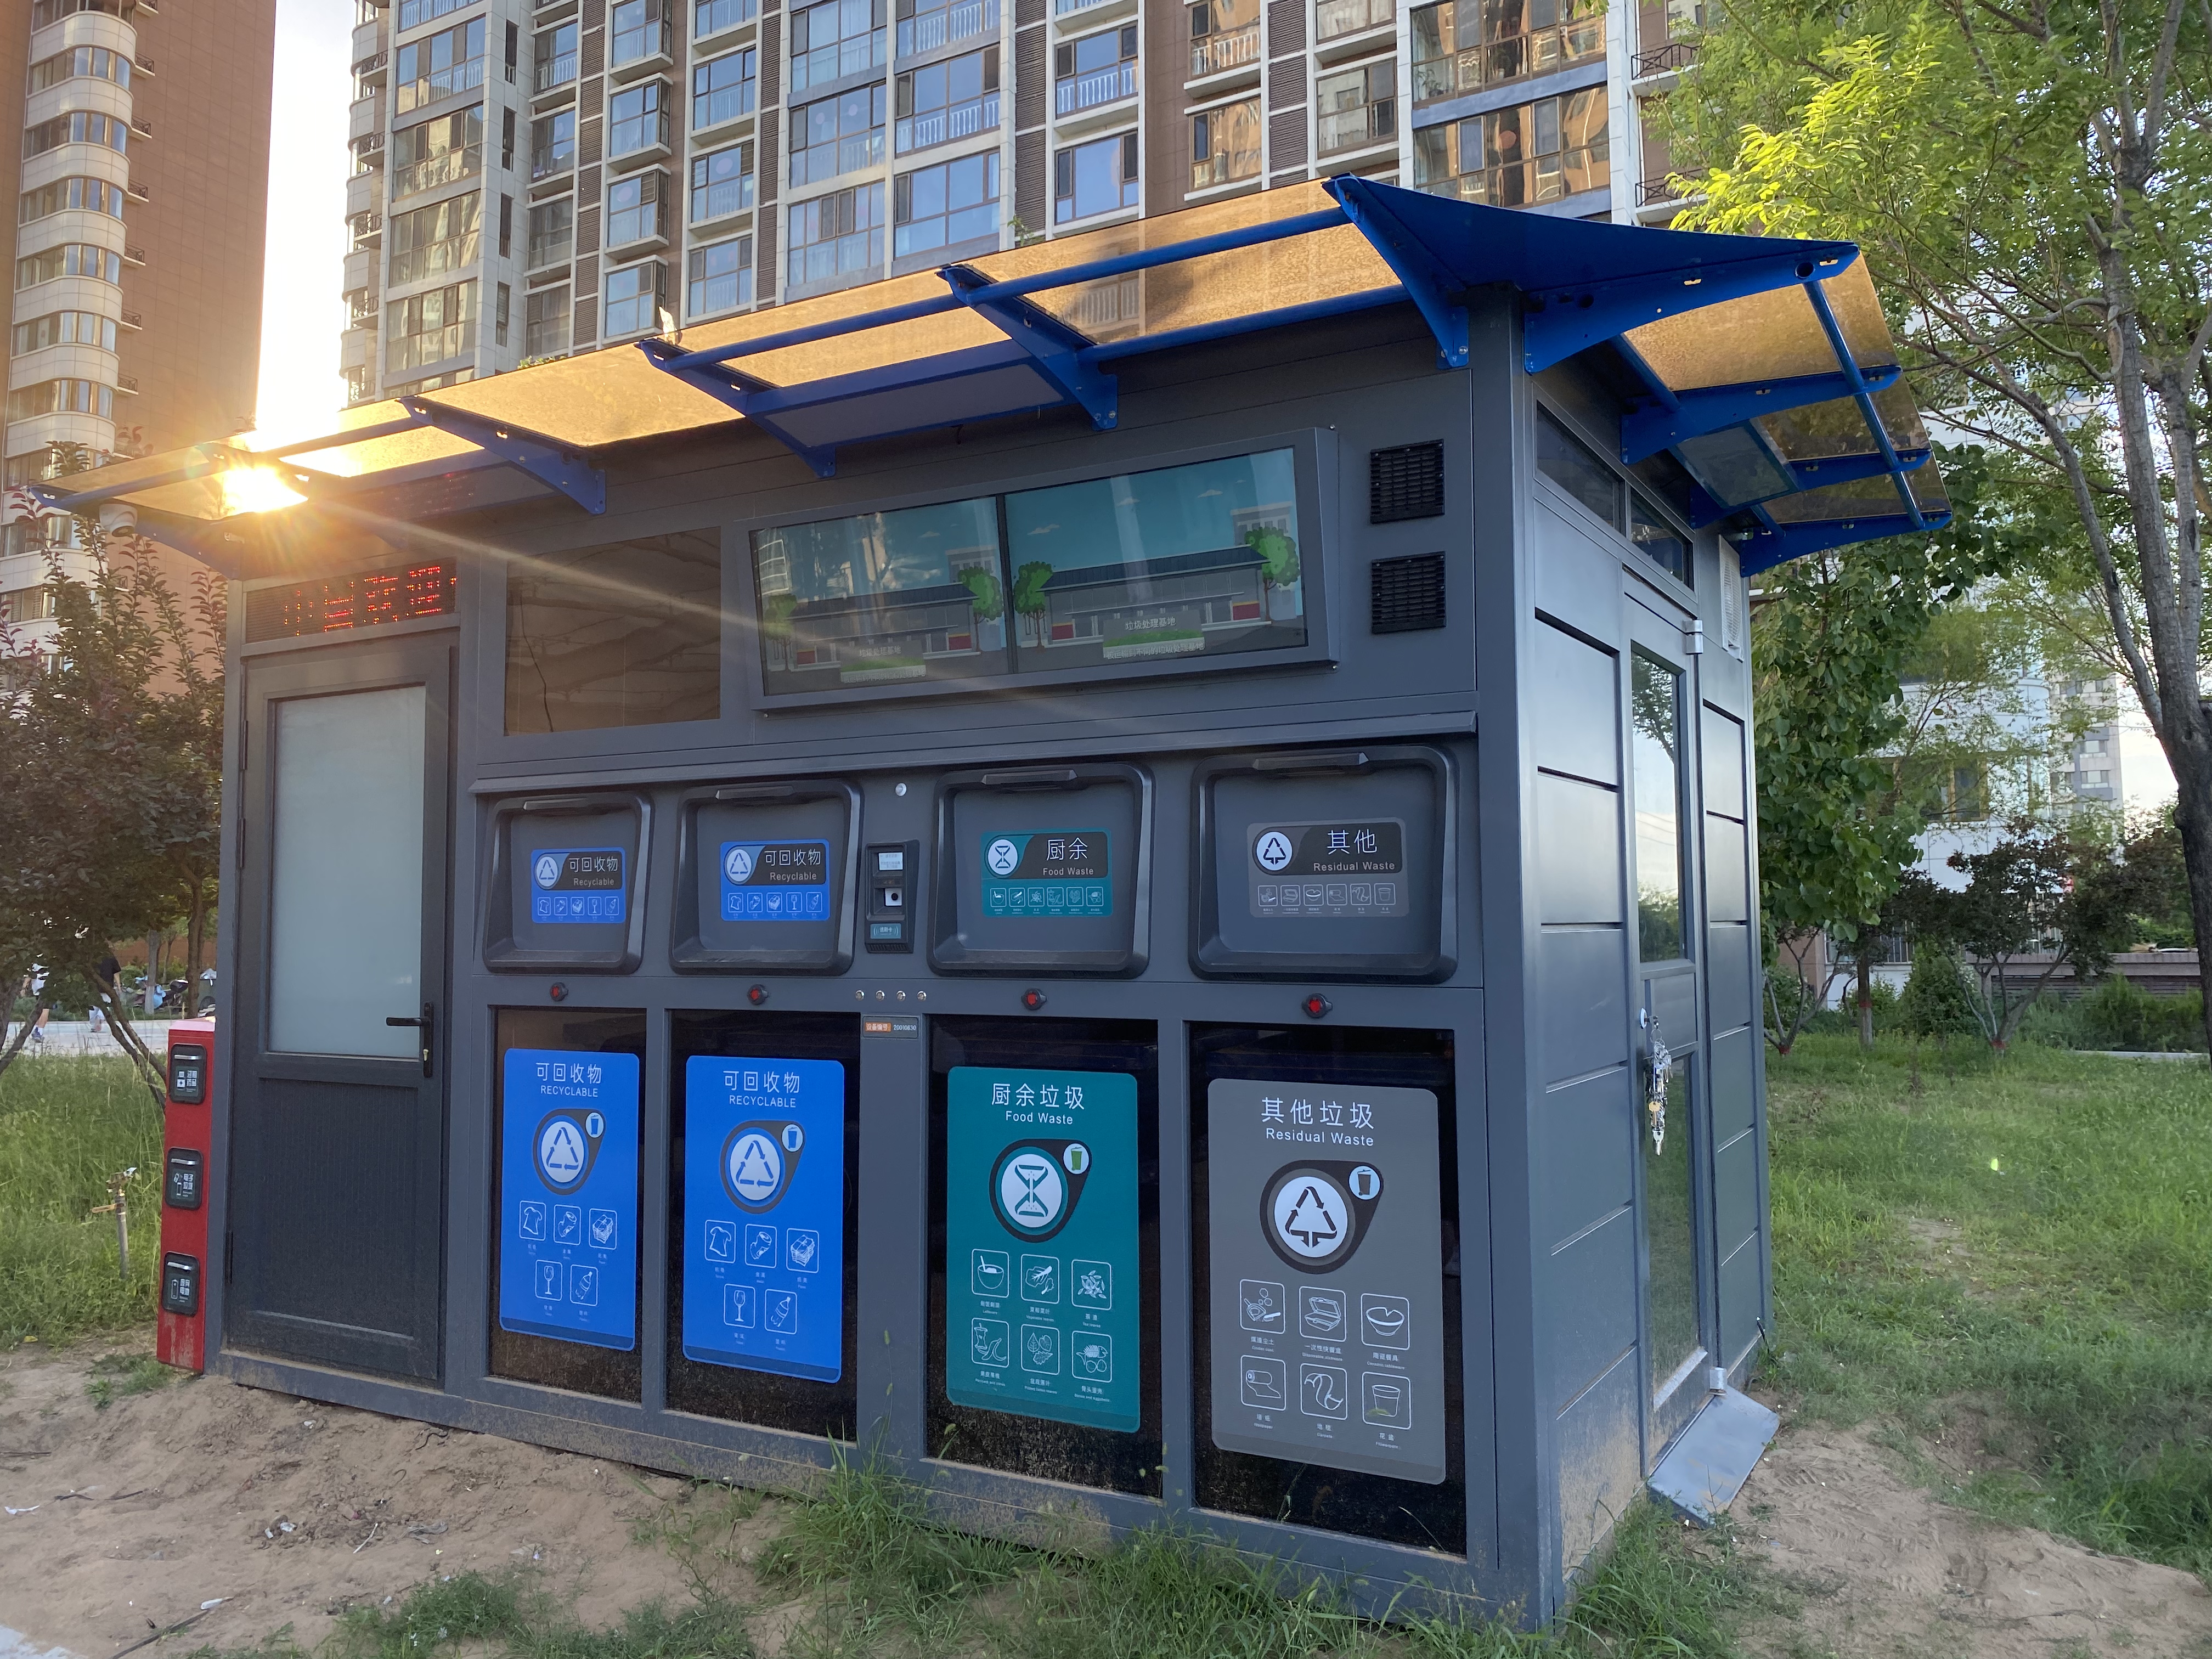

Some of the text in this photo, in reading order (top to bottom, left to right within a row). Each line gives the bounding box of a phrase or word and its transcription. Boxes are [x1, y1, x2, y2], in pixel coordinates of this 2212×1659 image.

[1125, 616, 1177, 630] 垃圾处理基地
[1046, 837, 1088, 861] 厨余
[1327, 828, 1378, 855] 其他
[568, 856, 618, 873] 可回收物
[763, 848, 821, 866] 可回收物
[1043, 867, 1094, 876] Food Waste
[1313, 861, 1395, 871] Residual Waste
[573, 878, 614, 887] Recyclable
[770, 872, 817, 882] Recyclable
[535, 1062, 602, 1085] 可回收物
[723, 1070, 800, 1093] 可回收物
[540, 1085, 599, 1097] RECYCLABLE
[991, 1082, 1085, 1110] 厨余垃圾
[729, 1094, 797, 1108] RECYCLABLE
[1005, 1111, 1073, 1125] Food Waste
[1261, 1097, 1374, 1130] 其他垃圾
[1266, 1127, 1374, 1147] Residual Waste
